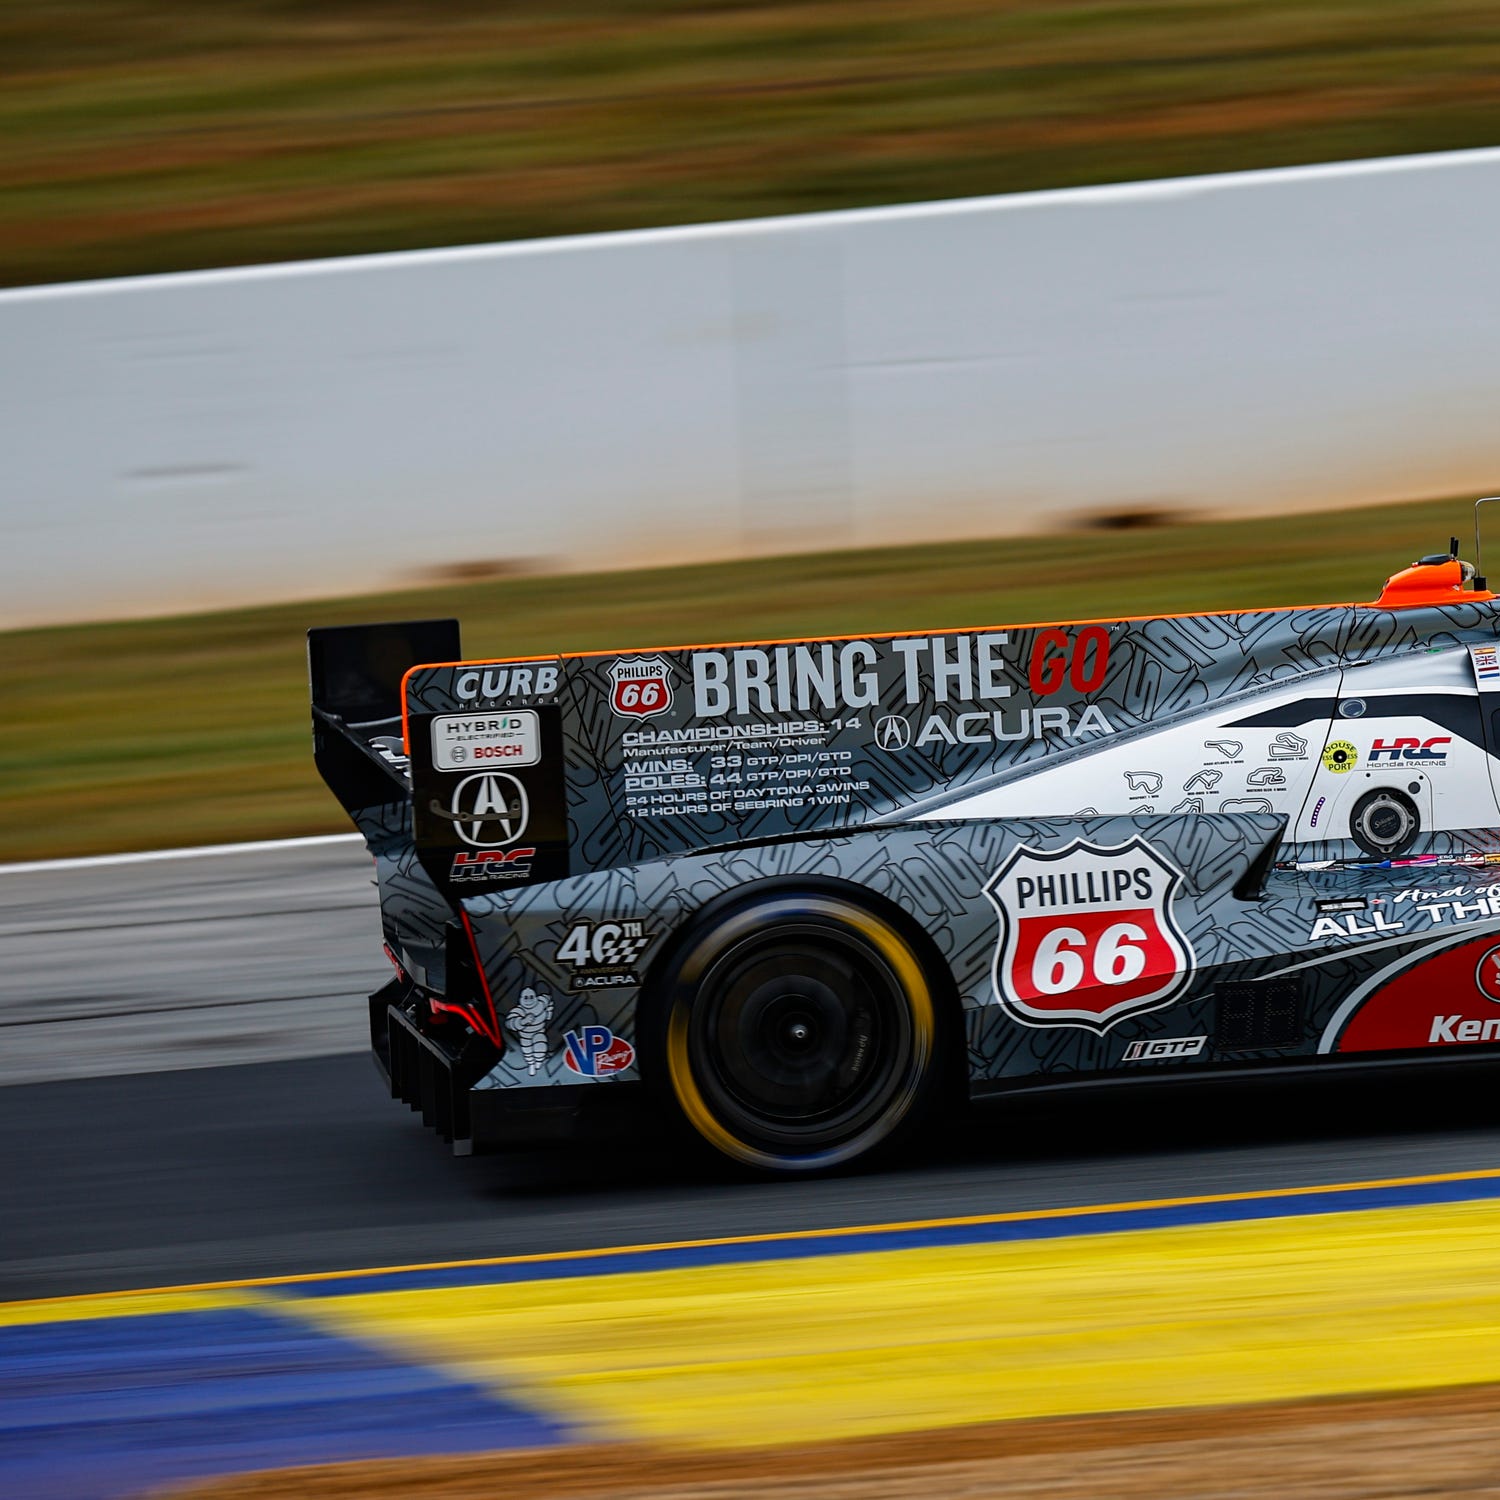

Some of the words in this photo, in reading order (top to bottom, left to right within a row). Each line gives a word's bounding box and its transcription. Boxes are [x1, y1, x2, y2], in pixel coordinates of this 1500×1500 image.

[456, 667, 559, 700] CURB
[617, 665, 663, 679] PHILLIPS
[692, 639, 880, 718] BRING
[893, 633, 1012, 704] THE
[1028, 626, 1112, 696] GO
[459, 696, 559, 709] RECORDS
[621, 682, 661, 707] 66
[622, 719, 826, 746] CHAMPIONSHIPS:
[830, 717, 862, 731] 14
[916, 704, 1115, 747] ACURA
[474, 745, 523, 759] BOSCH
[623, 735, 827, 758] Manufacturer/Team/Driver
[1324, 742, 1358, 754] DOUSE
[1367, 737, 1453, 761] HRC
[624, 758, 694, 775] WINS:
[710, 755, 743, 770] 33
[746, 751, 852, 767] GTP/DPI/GTD
[1328, 763, 1353, 771] PORT
[625, 773, 706, 790] POLES:
[709, 772, 743, 786] 44
[746, 766, 852, 783] GTP/DPI/GTD
[626, 795, 649, 806] 24
[650, 791, 707, 805] HOURS
[709, 789, 732, 800] OF
[733, 785, 813, 799] DAYTONA
[628, 808, 649, 818] 12
[651, 804, 708, 817] HOURS
[709, 802, 732, 813] OF
[734, 798, 804, 811] SEBRING
[449, 847, 537, 878] HRC
[489, 872, 530, 880] RACING
[1016, 867, 1153, 909] PHILLIPS
[1392, 885, 1471, 903] And
[1308, 911, 1404, 941] ALL
[1031, 922, 1148, 996] 66
[584, 975, 636, 986] ACURA
[563, 1026, 613, 1076] VP
[1149, 1039, 1200, 1055] GTP
